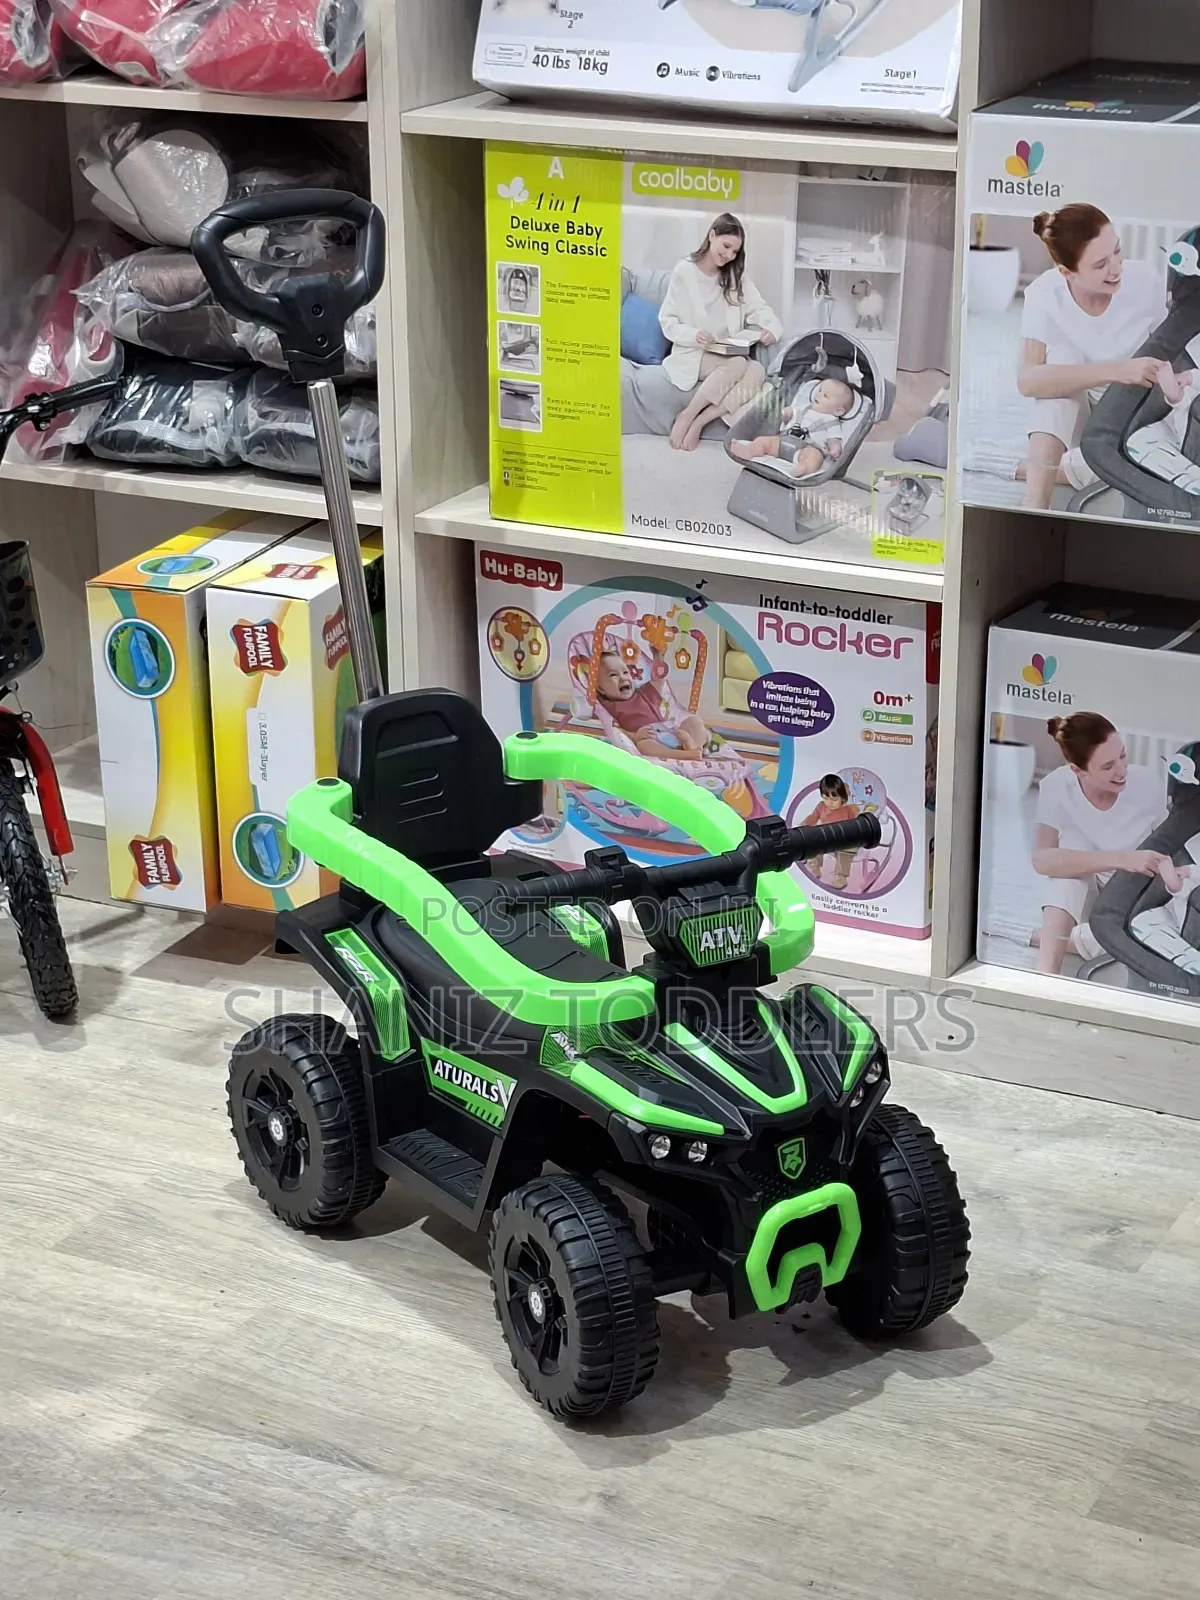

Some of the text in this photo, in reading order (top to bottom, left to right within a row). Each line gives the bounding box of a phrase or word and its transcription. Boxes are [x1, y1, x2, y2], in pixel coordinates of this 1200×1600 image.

[560, 10, 584, 20] Stage
[567, 20, 574, 29] 2
[532, 54, 549, 68] 40
[552, 55, 571, 70] lbs
[674, 67, 700, 77] Music
[638, 167, 734, 199] coolbaby
[987, 178, 1061, 197] mastela
[548, 192, 565, 211] in
[510, 215, 604, 241] Deluxe Baby
[505, 234, 608, 257] Swing Classic
[631, 513, 732, 537] Model: CB02003
[484, 556, 559, 586] Hu-Baby
[759, 594, 894, 625] Infant-to-toddler
[1050, 612, 1141, 633] mastela
[757, 611, 914, 659] Rocker
[242, 627, 258, 669] FUNPOOL
[253, 626, 274, 668] FAMILY
[762, 680, 820, 697] Vibrations that
[1006, 683, 1073, 705] mastela
[766, 691, 817, 709] imitate being
[768, 714, 781, 723] get
[781, 715, 790, 723] to
[779, 703, 810, 718] helping
[810, 709, 831, 721] baby
[878, 713, 902, 723] Music
[876, 734, 912, 745] Vibrations
[140, 843, 161, 883] FAMILY
[155, 844, 171, 882] FUNPOOL
[811, 893, 833, 905] Easily
[835, 899, 869, 911] converts
[871, 904, 880, 912] to
[823, 902, 880, 919] toddler rocker
[700, 924, 743, 952] ATV
